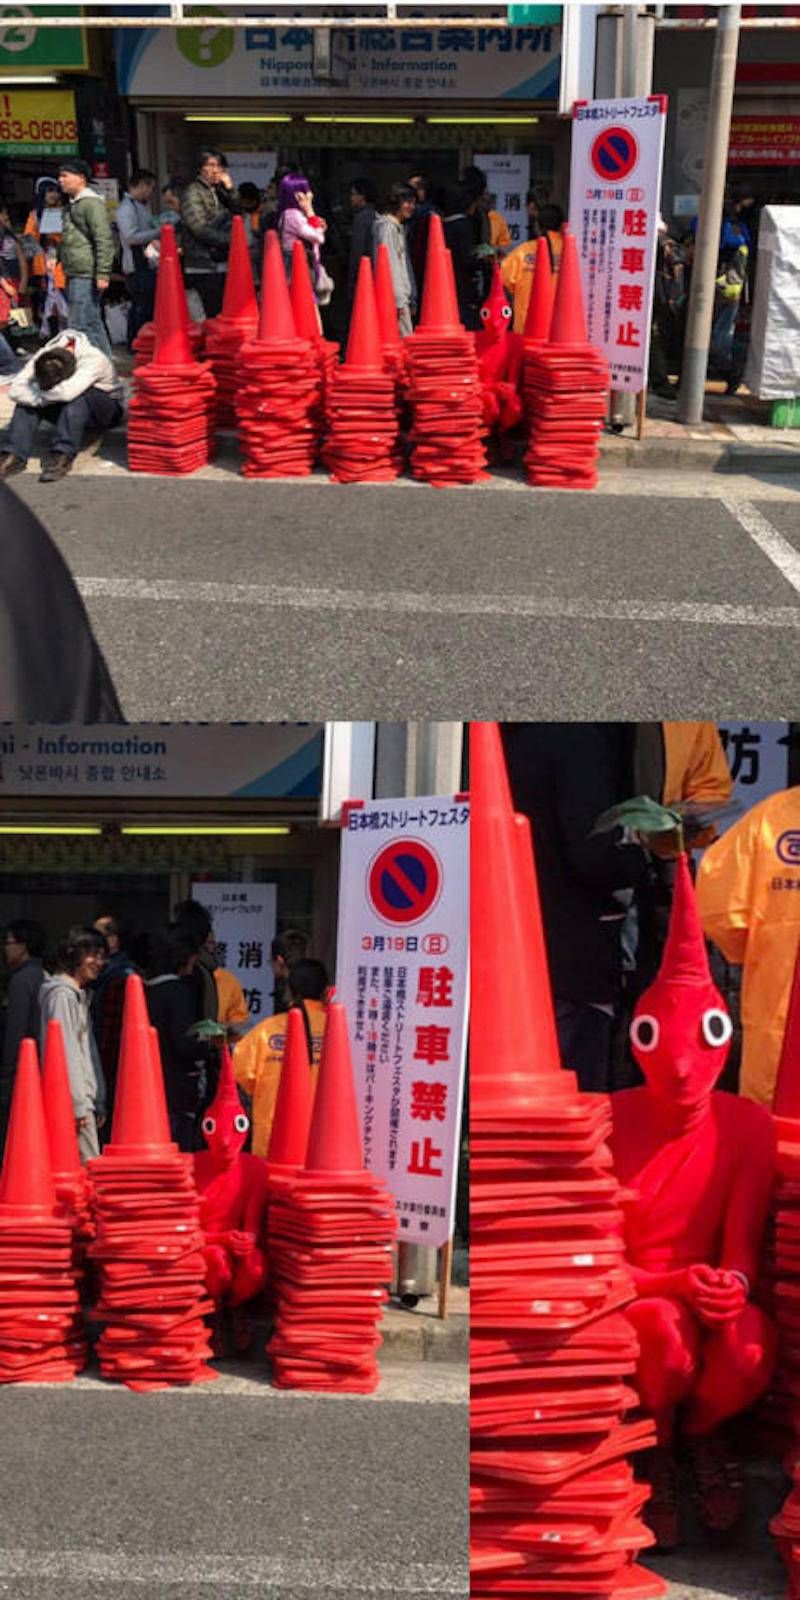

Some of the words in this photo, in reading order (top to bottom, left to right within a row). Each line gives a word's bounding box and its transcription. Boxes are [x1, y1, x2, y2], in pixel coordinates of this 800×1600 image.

[371, 58, 457, 71] Information
[615, 208, 648, 348] 駐車禁止
[37, 735, 167, 755] Information
[361, 936, 418, 951] 3月19日
[406, 966, 454, 1178] 駐車禁止
